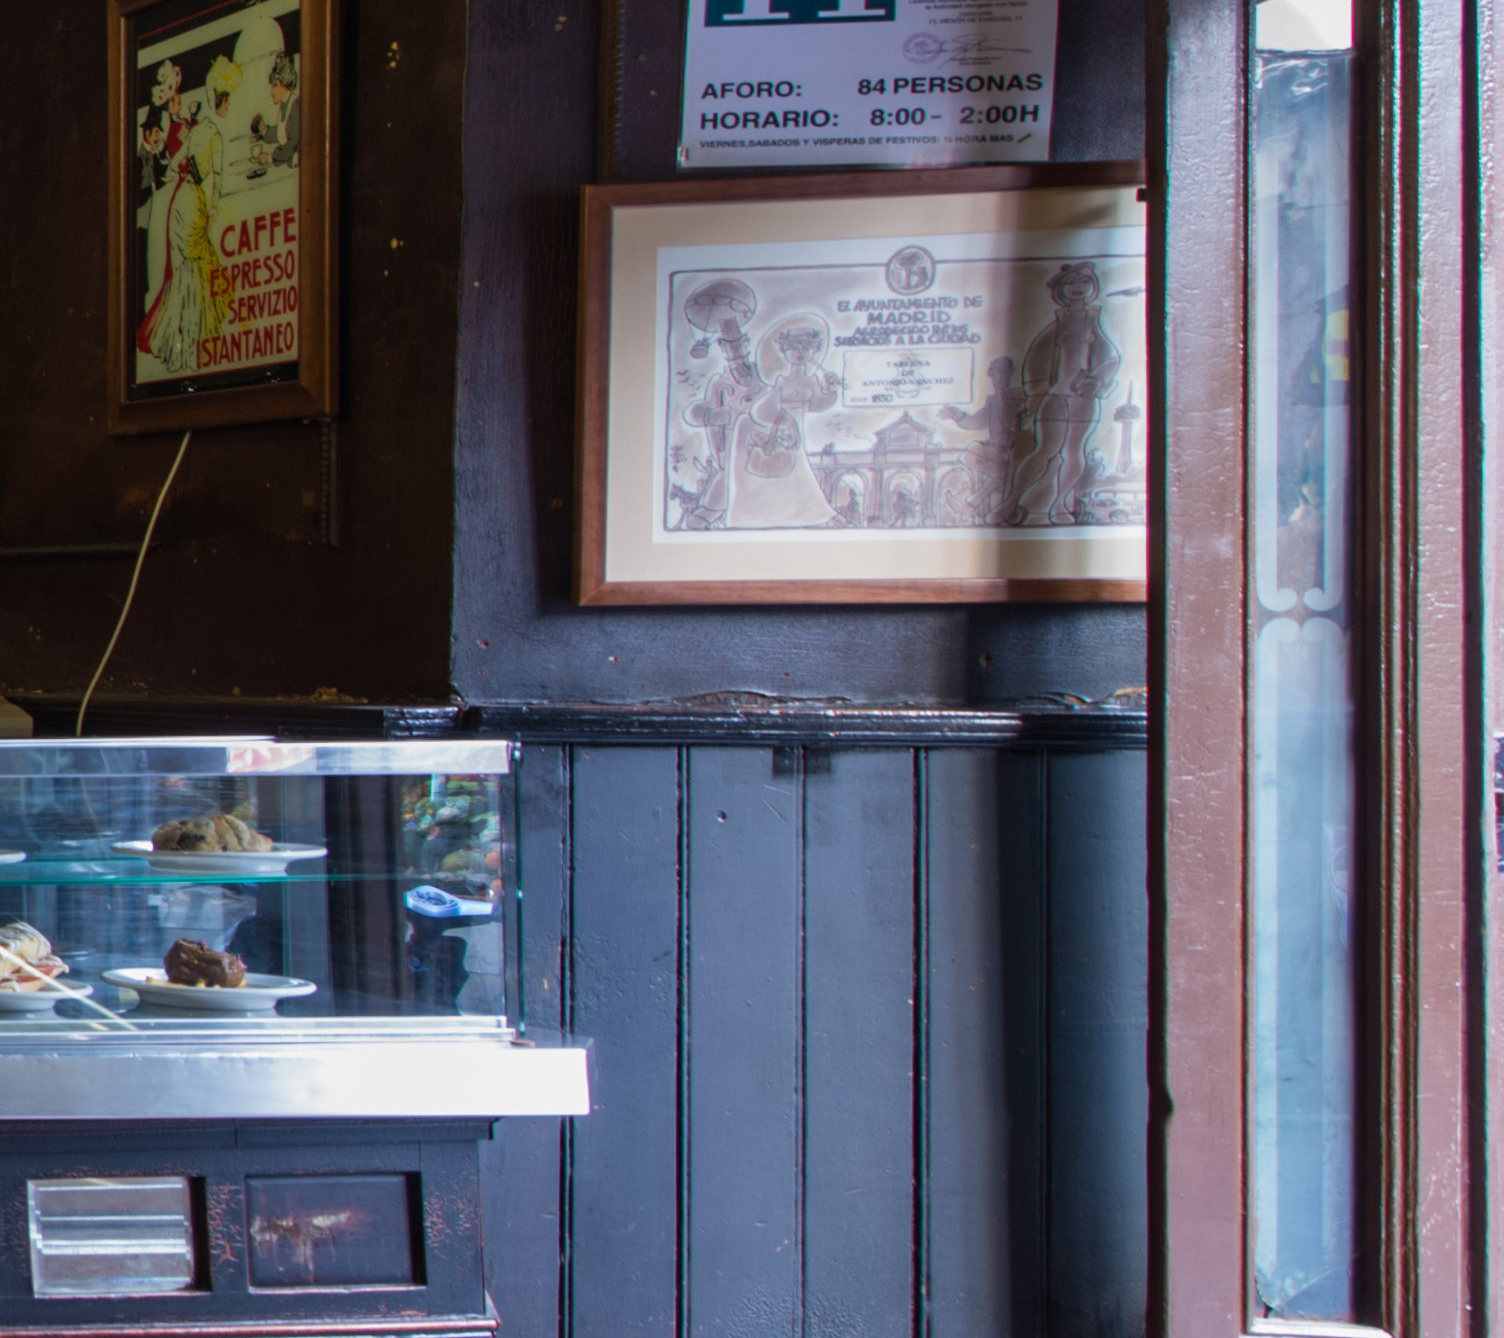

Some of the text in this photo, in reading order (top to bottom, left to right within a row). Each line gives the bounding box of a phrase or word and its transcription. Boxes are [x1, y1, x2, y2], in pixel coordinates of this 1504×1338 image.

[701, 73, 1043, 100] AFORO: 84 PERSONAS
[700, 108, 840, 130] HORARIO:
[870, 107, 926, 127] 8:00
[959, 104, 1040, 126] 2:00H
[812, 137, 866, 147] VISPERAS
[868, 136, 883, 146] DE
[955, 134, 987, 144] HORA
[989, 134, 1014, 143] MAS
[220, 207, 297, 258] CAFFE
[209, 249, 295, 298] ESPRESSO
[228, 285, 298, 325] SERVIZIO
[853, 296, 959, 312] AYUNTAMIENTO
[963, 295, 983, 308] DE
[867, 310, 951, 326] MADRID
[195, 321, 295, 369] ISTANTANEO
